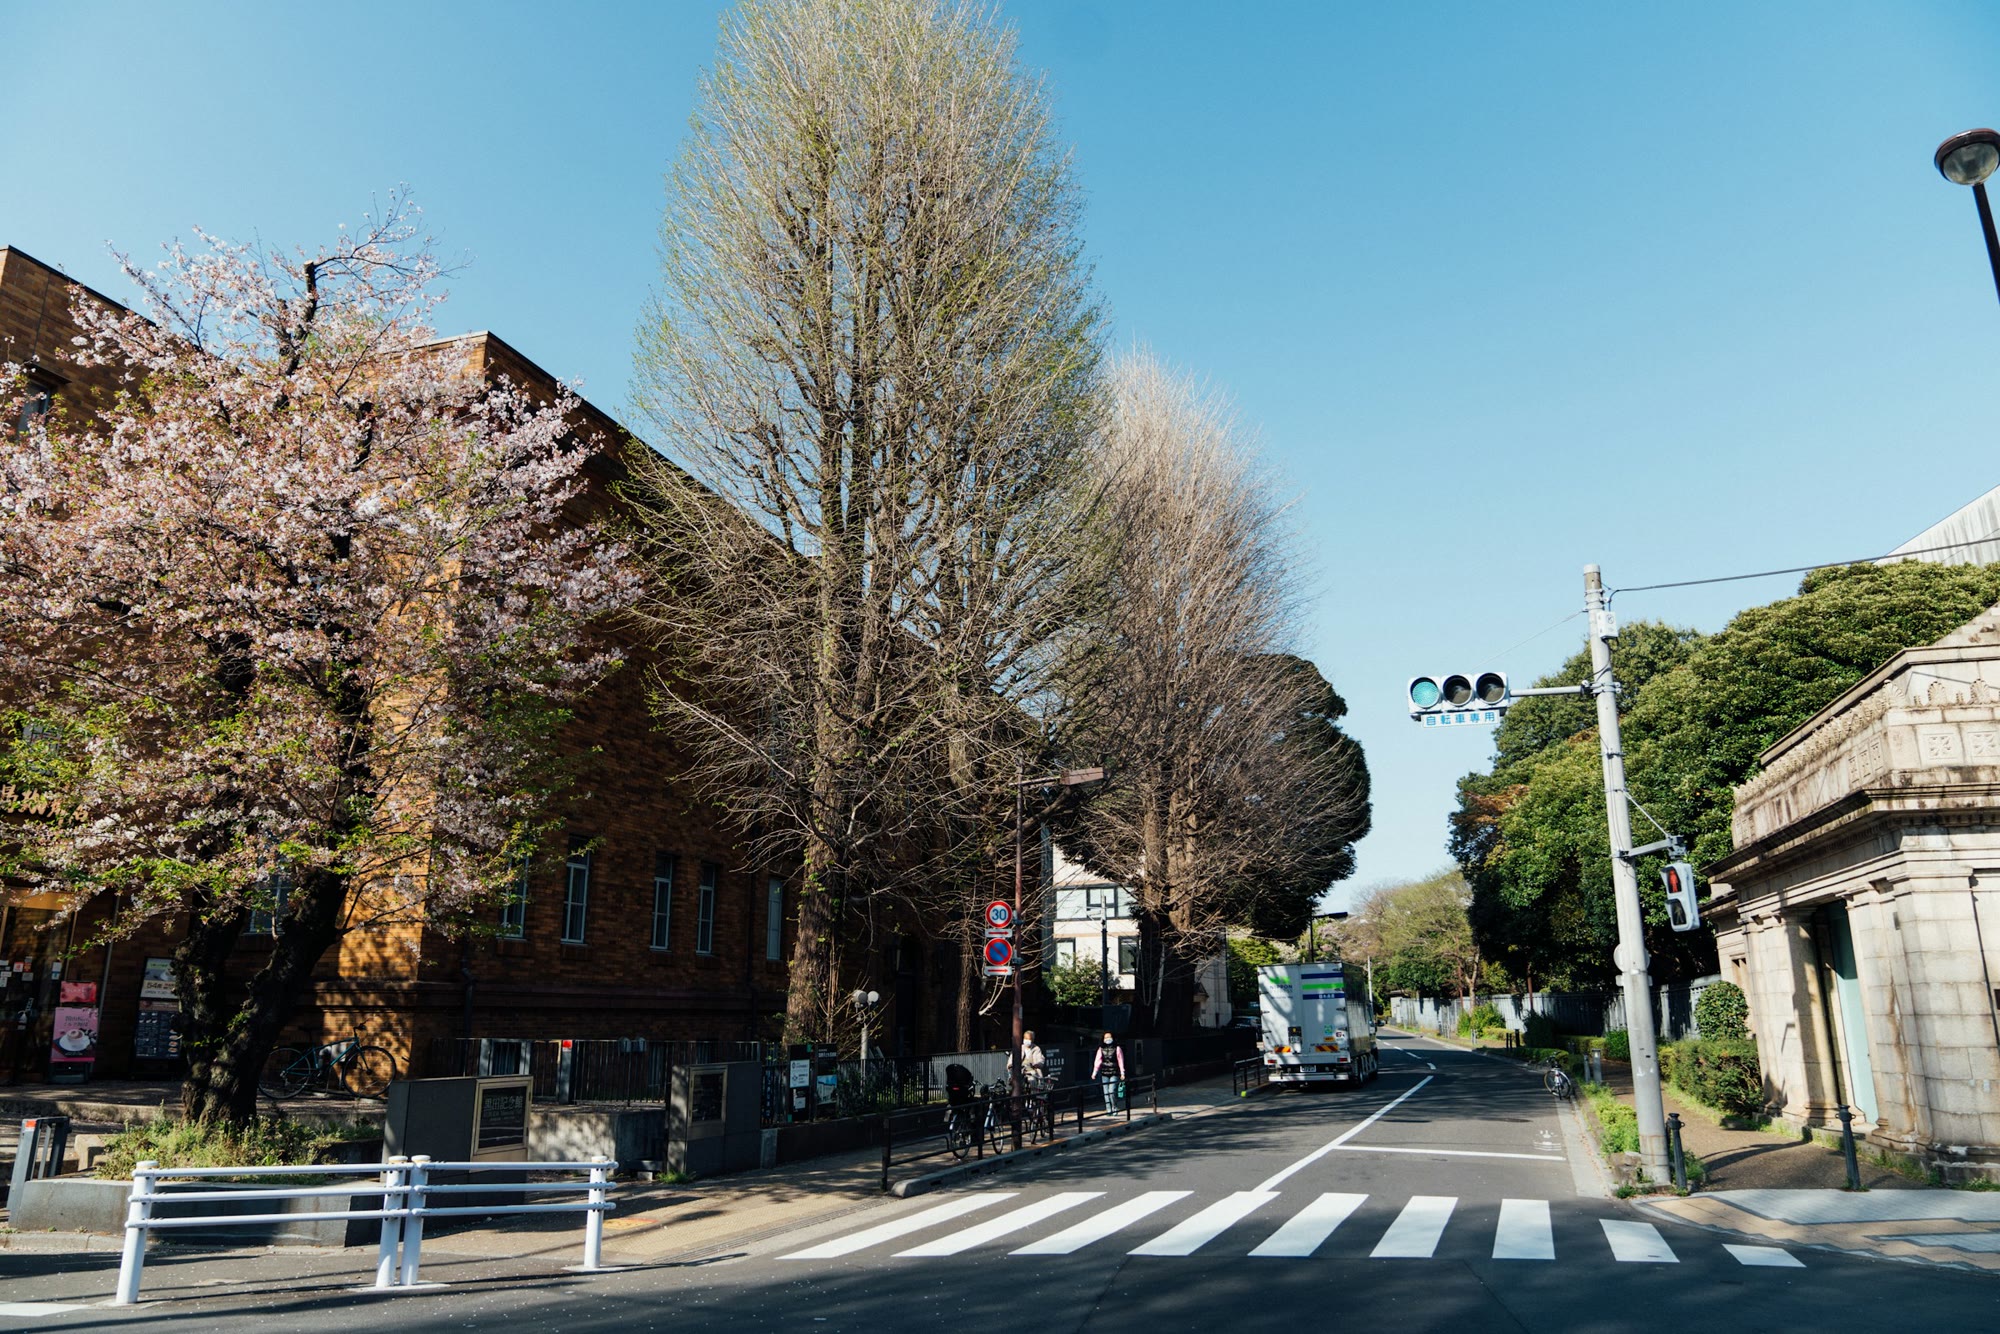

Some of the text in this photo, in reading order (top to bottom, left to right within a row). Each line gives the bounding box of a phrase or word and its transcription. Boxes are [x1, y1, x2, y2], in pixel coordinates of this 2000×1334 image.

[1426, 711, 1495, 726] 自転車専用
[991, 908, 1007, 921] 30
[484, 1096, 523, 1111] 黒田記念館
